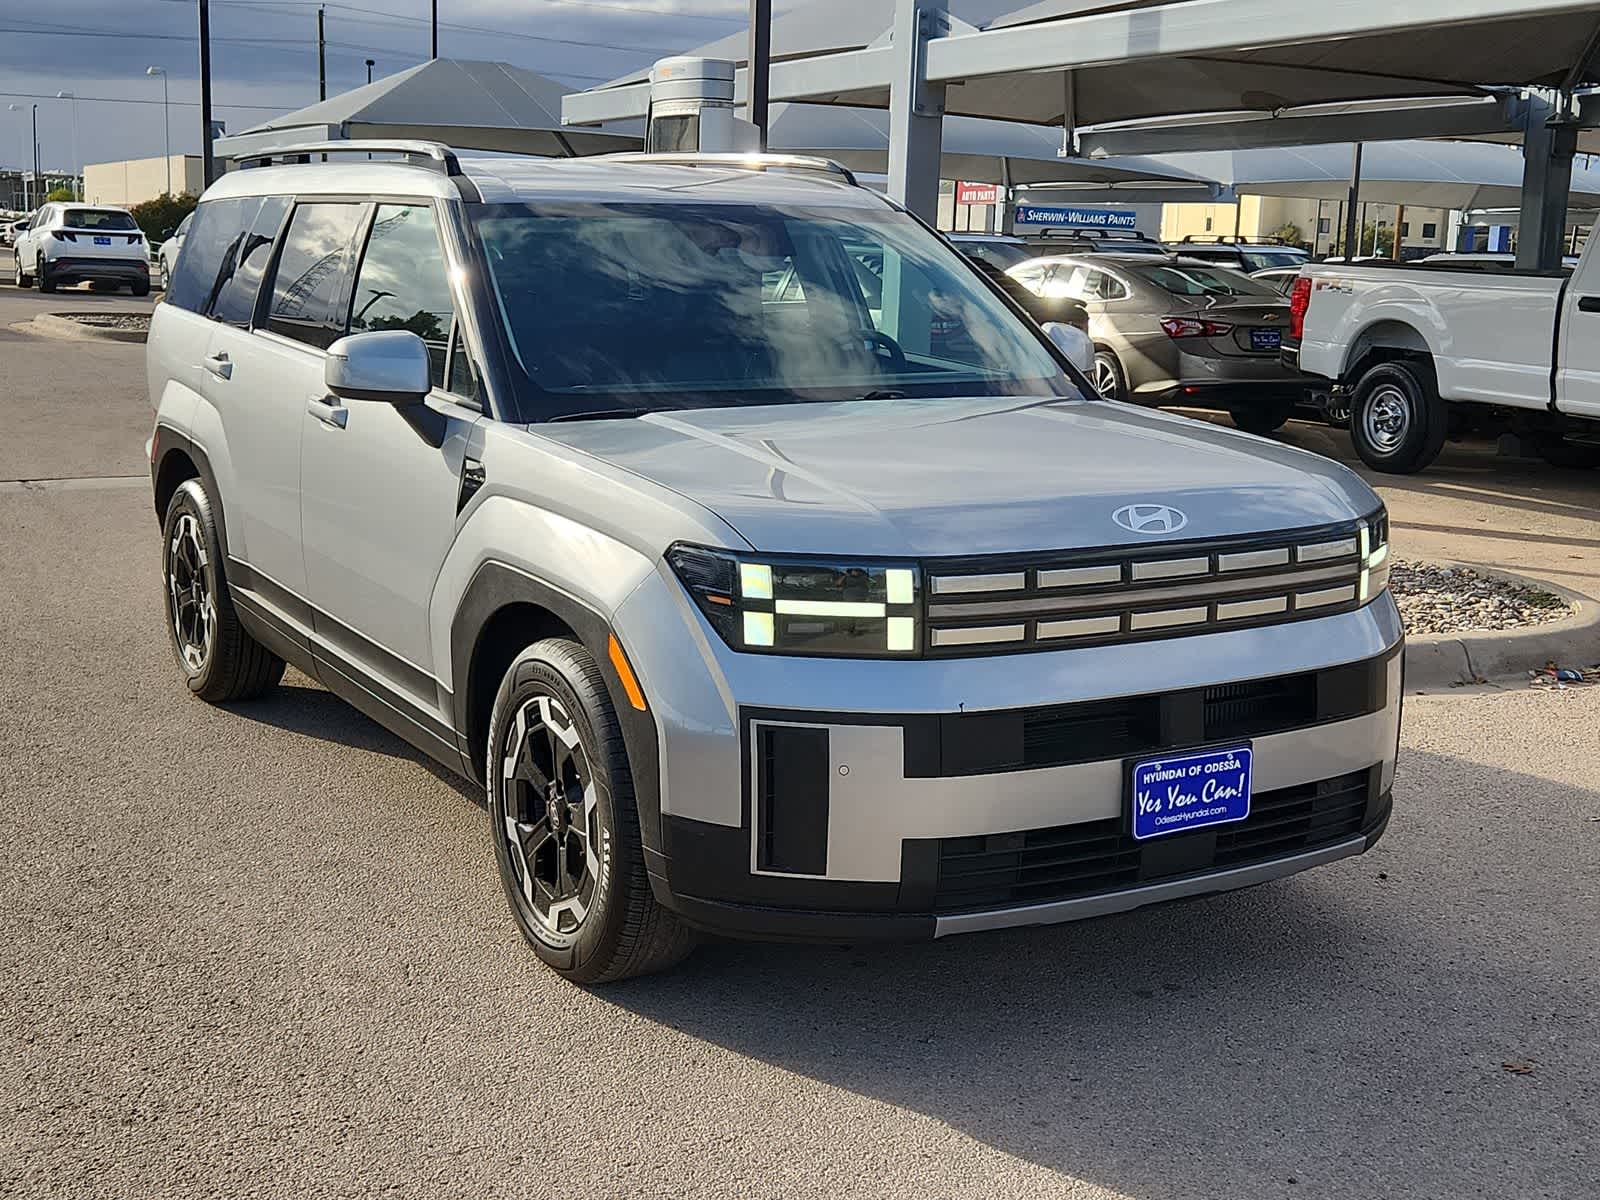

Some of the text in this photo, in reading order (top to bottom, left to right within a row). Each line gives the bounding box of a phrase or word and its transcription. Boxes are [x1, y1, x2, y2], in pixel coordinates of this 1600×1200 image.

[977, 191, 995, 201] PARTS
[1026, 209, 1136, 226] SHERWIN-WILLIAMS PAINTS
[1143, 759, 1241, 785] HYUNDAI OF ODESSA
[1138, 772, 1246, 816] Yes You Can!
